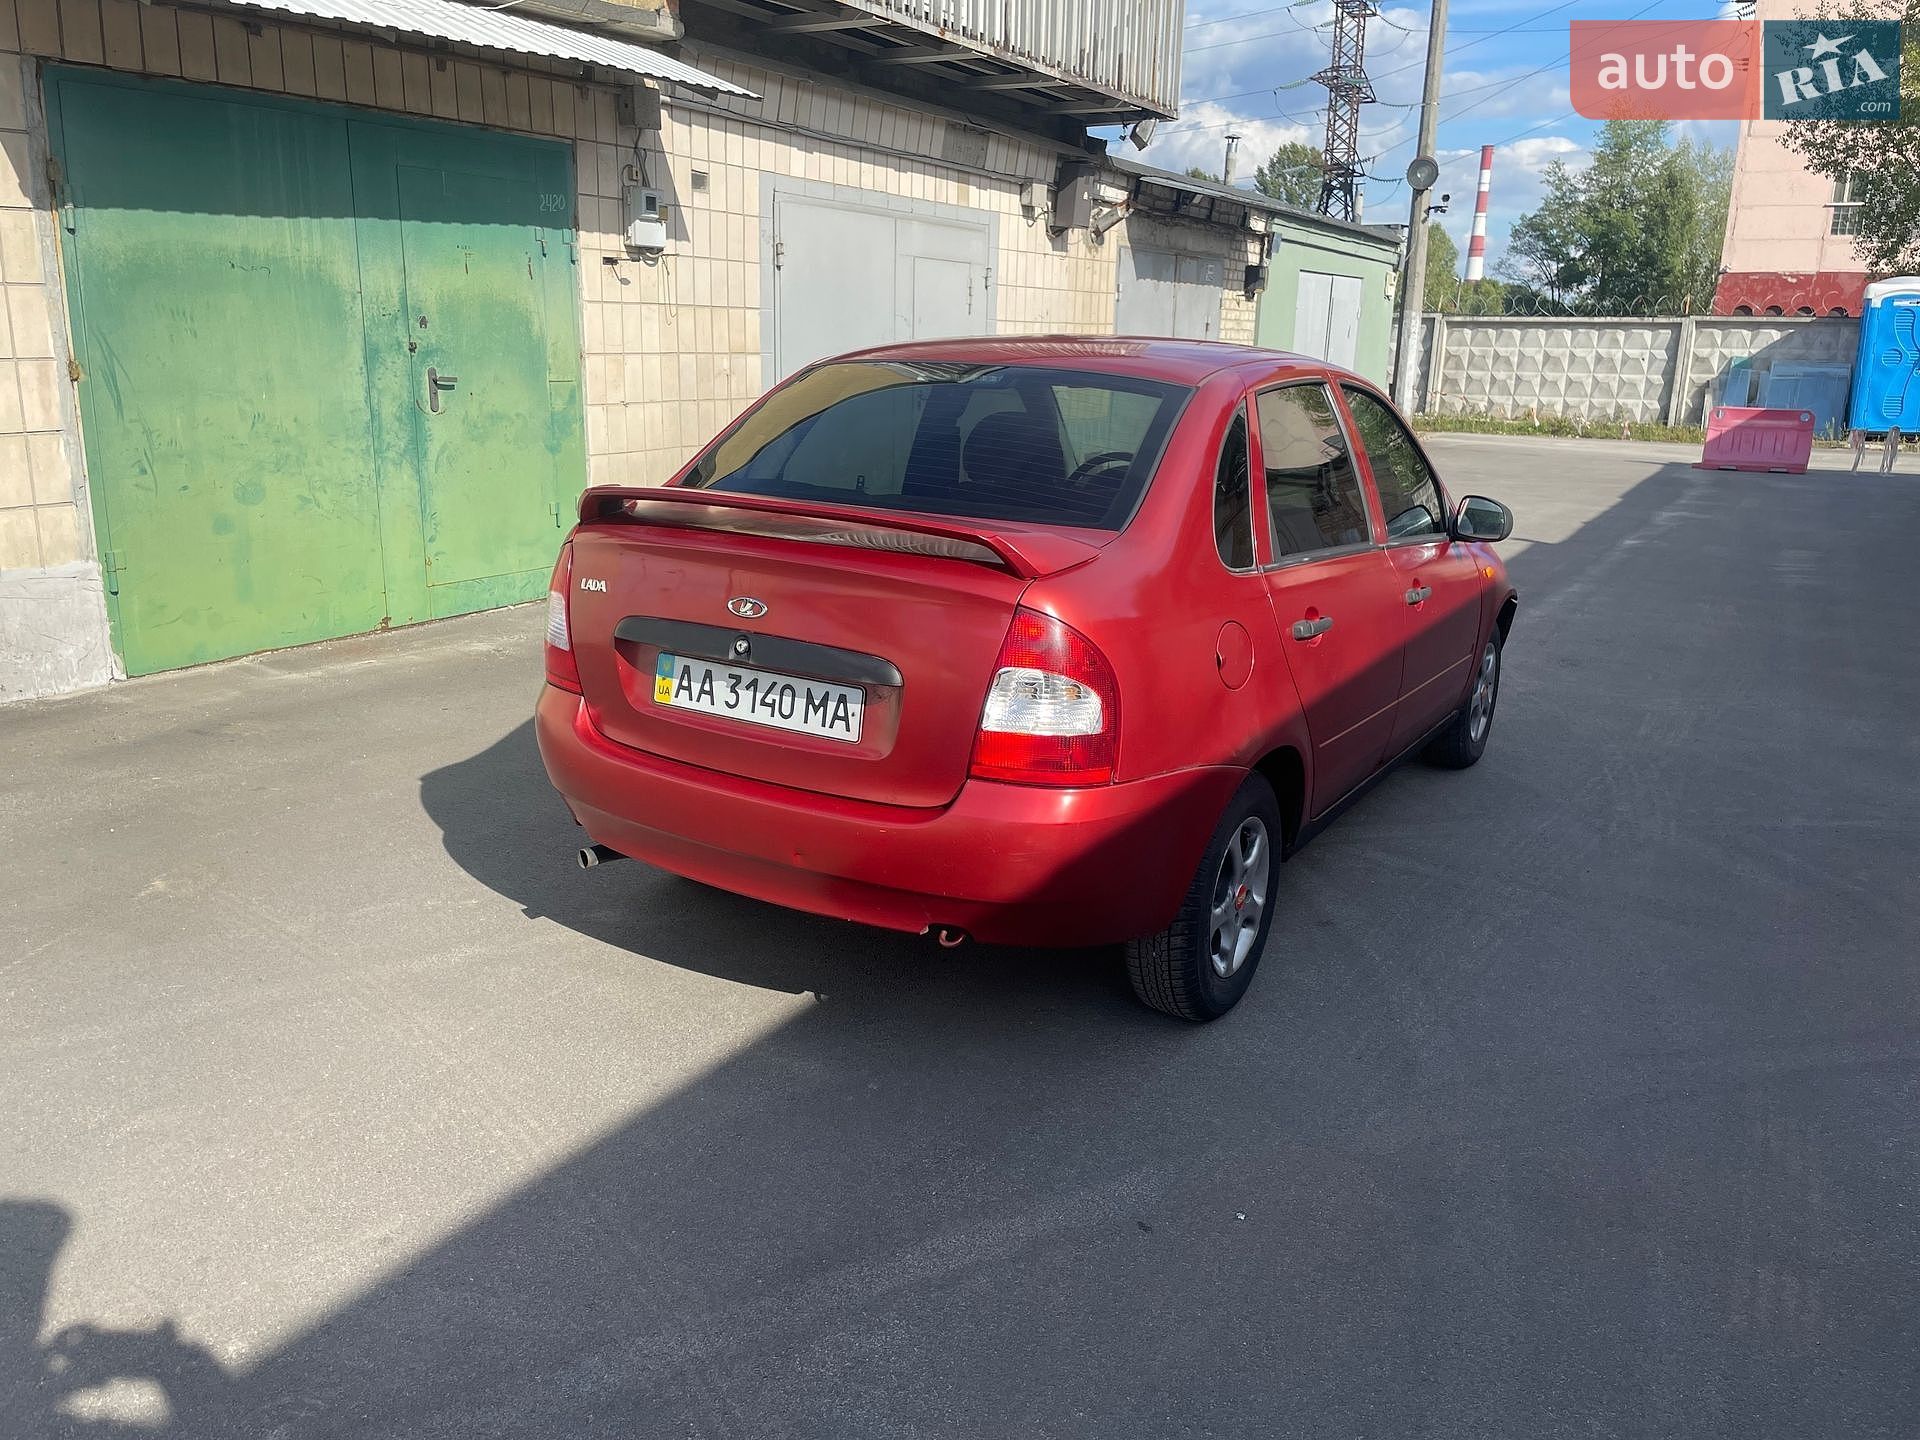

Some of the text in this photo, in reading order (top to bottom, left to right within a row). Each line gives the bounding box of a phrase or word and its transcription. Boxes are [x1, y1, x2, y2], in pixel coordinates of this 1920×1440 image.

[540, 194, 566, 212] 2420
[580, 577, 607, 593] LADA
[658, 687, 671, 697] UA
[674, 664, 851, 732] AA 3140 MA
